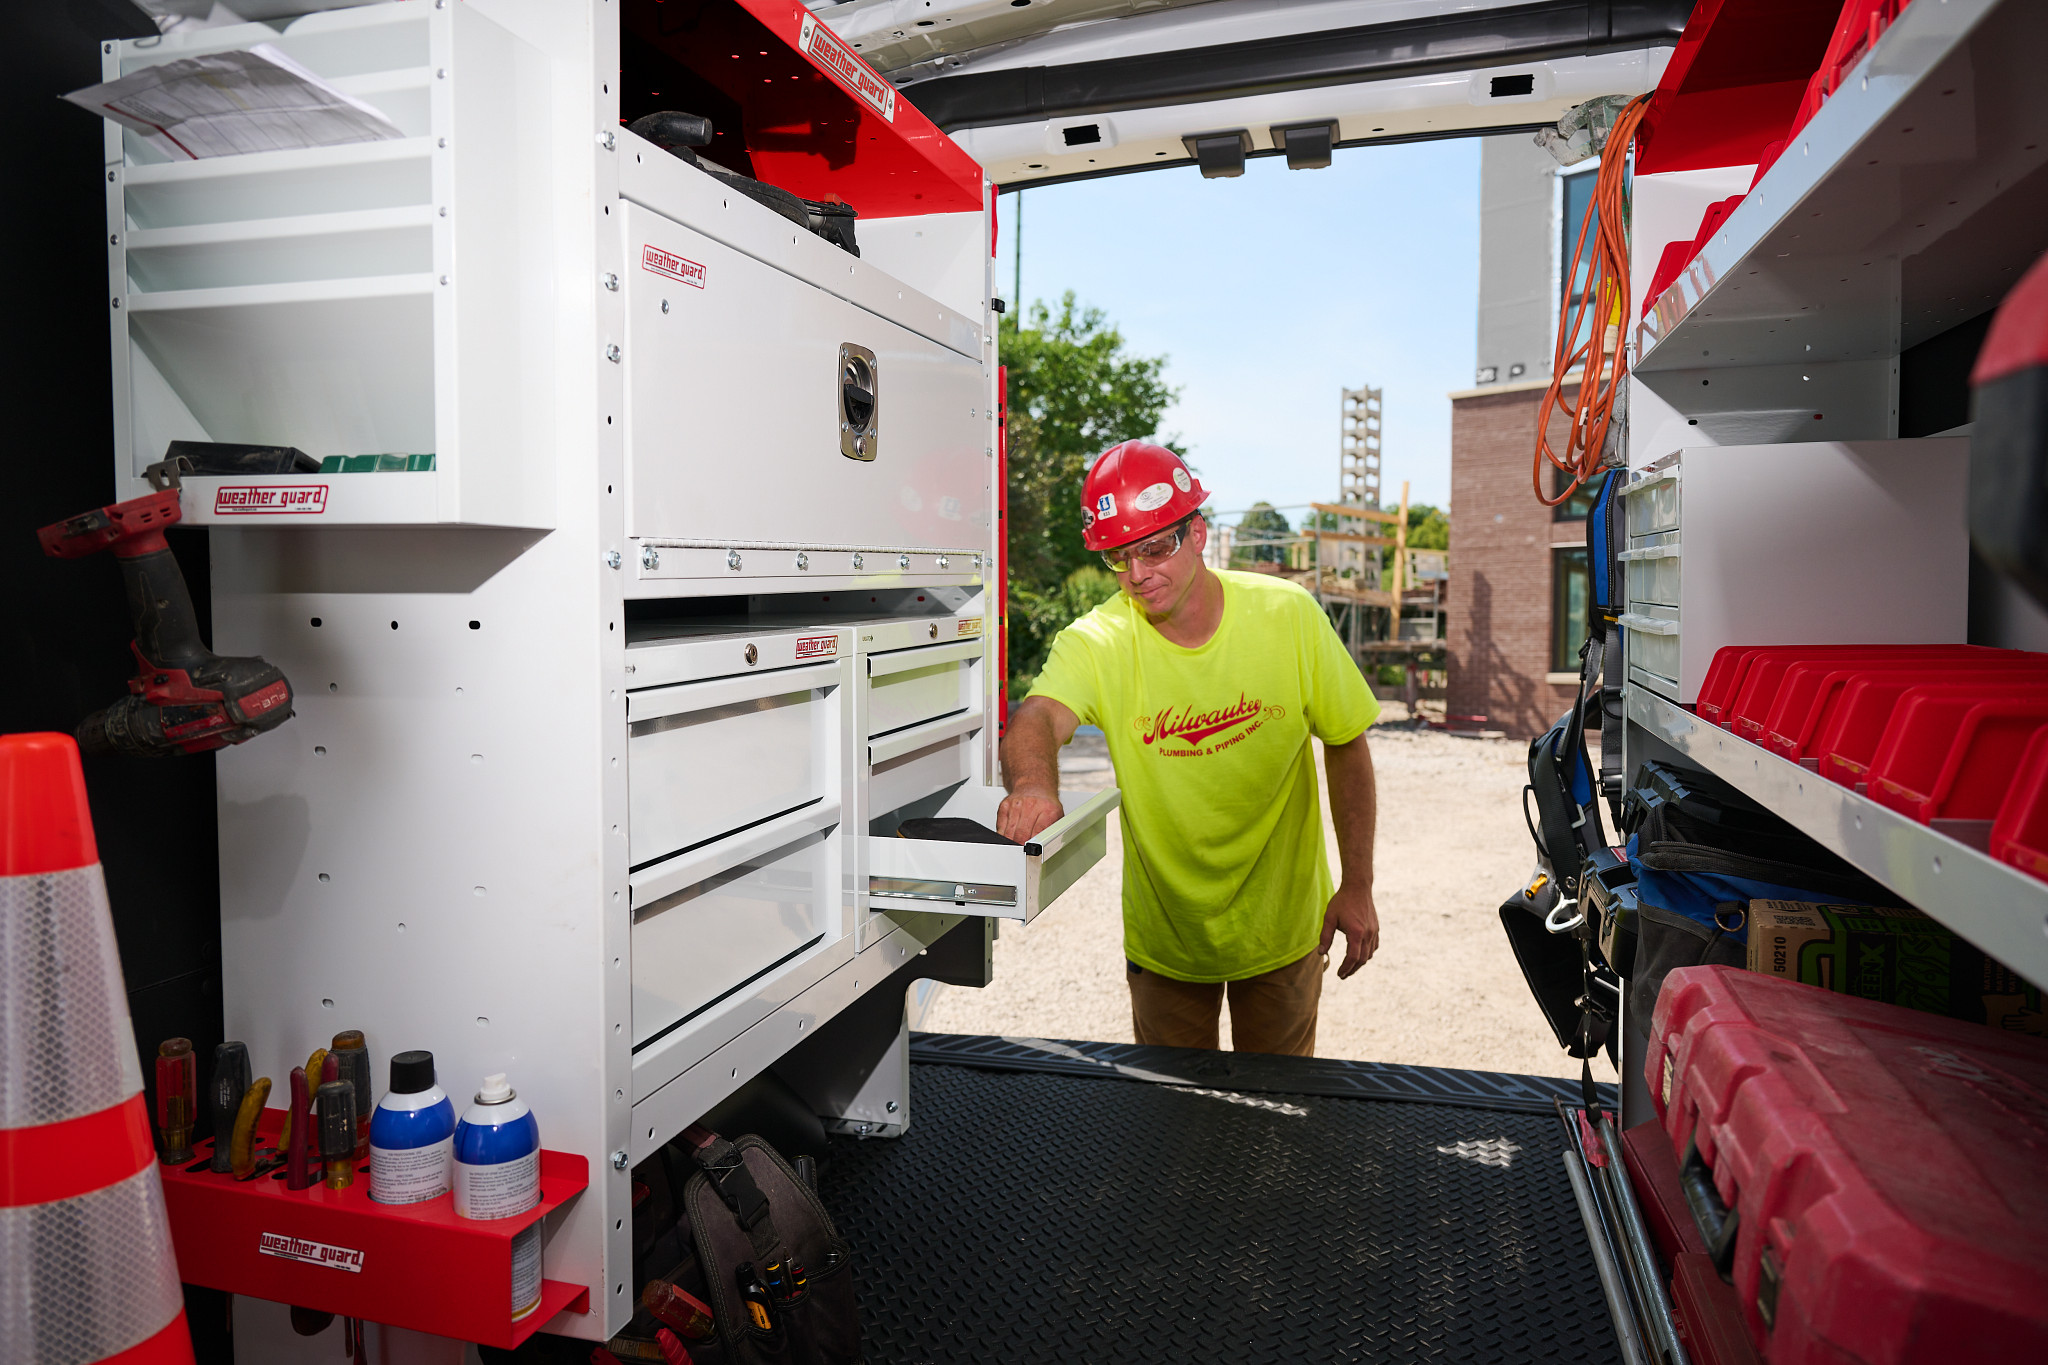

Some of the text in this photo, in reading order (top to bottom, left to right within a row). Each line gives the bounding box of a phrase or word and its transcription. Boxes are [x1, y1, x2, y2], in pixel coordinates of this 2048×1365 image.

[813, 34, 885, 104] weather guard
[646, 250, 679, 271] weather
[681, 263, 703, 280] guard
[219, 487, 323, 507] weather guard
[797, 637, 836, 651] weather guard
[252, 691, 287, 709] FUEL
[1143, 691, 1262, 745] Milwaukee
[1159, 747, 1203, 757] PLUMBING
[1215, 732, 1246, 753] PIPING
[1245, 719, 1264, 736] INC.
[1774, 936, 1786, 973] 50210
[262, 1235, 360, 1265] weather guard
